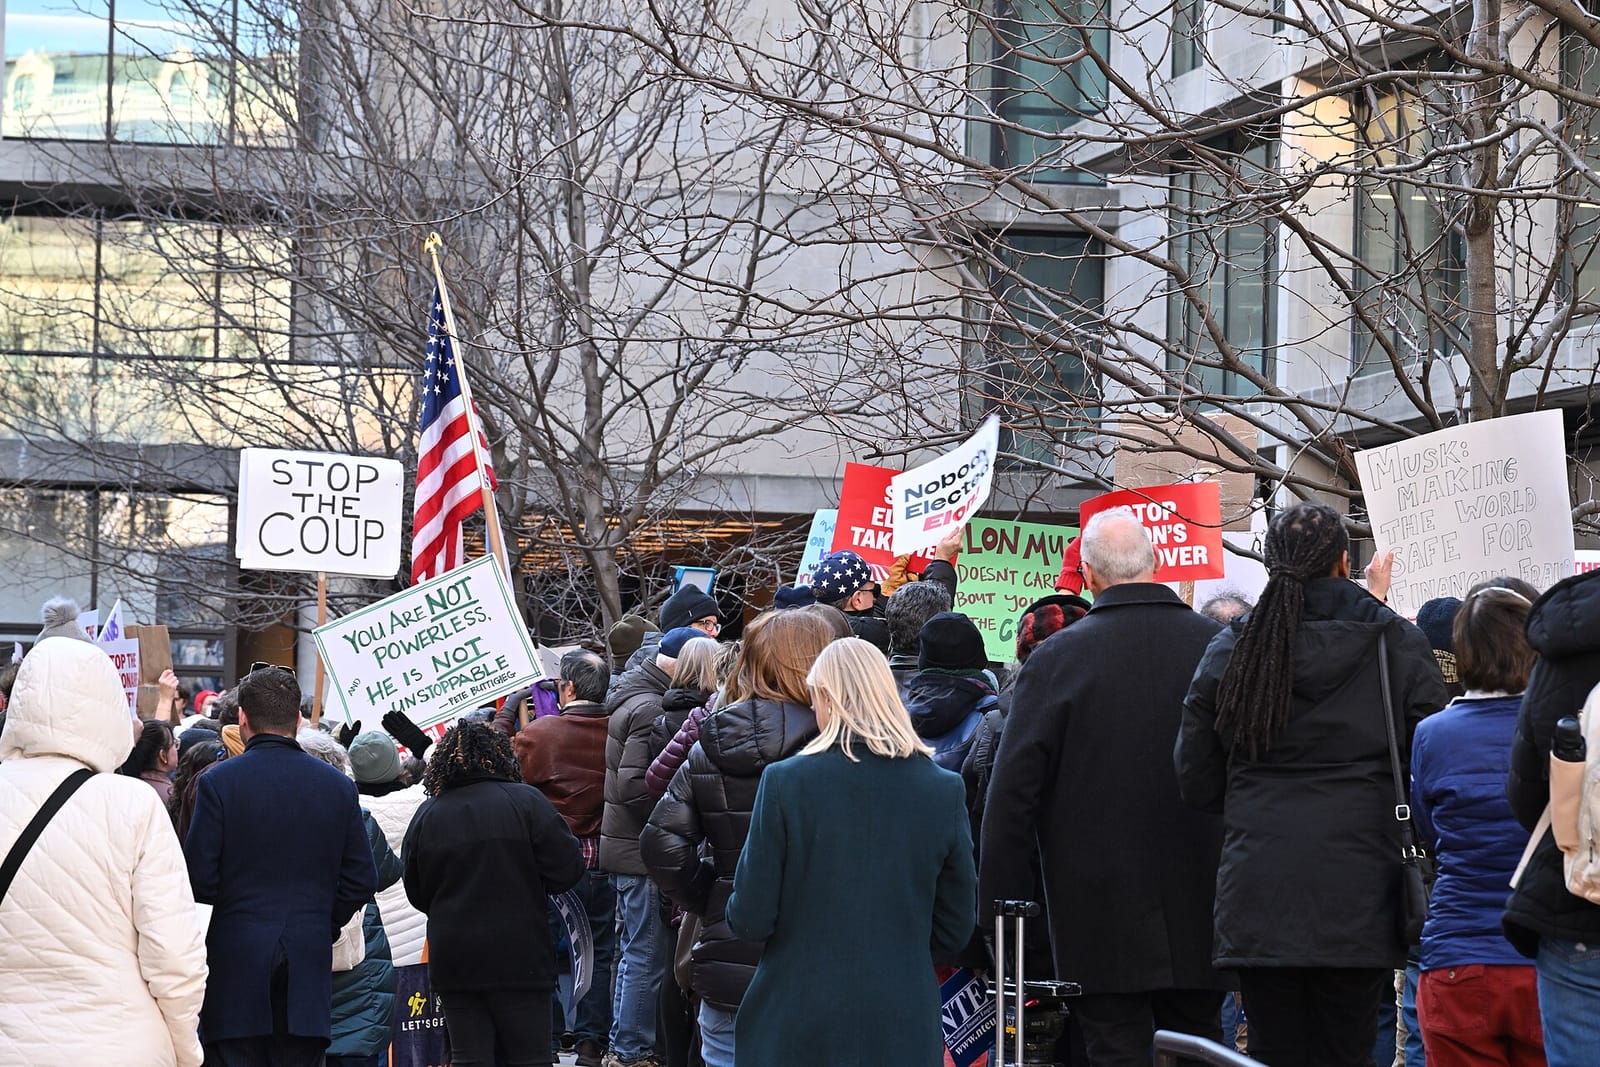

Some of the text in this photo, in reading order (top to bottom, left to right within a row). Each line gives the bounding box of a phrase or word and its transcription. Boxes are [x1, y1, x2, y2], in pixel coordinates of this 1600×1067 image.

[272, 459, 379, 493] STOP
[1367, 440, 1469, 491] MUSK:
[1397, 457, 1519, 511] MAKING
[292, 492, 361, 519] THE
[1380, 487, 1537, 545] THE WORLD
[259, 511, 384, 559] COUP
[958, 522, 1021, 555] LON
[1390, 519, 1533, 579] SAFE FOR
[957, 563, 1019, 586] DOESN'T
[342, 576, 473, 654] YOU ARE NOT
[372, 606, 492, 669] POWERLESS,
[347, 678, 362, 696] AND
[366, 636, 482, 706] HE IS NOT
[391, 655, 509, 713] UNSTOPPABLE
[402, 1017, 446, 1031] LET'S GE
